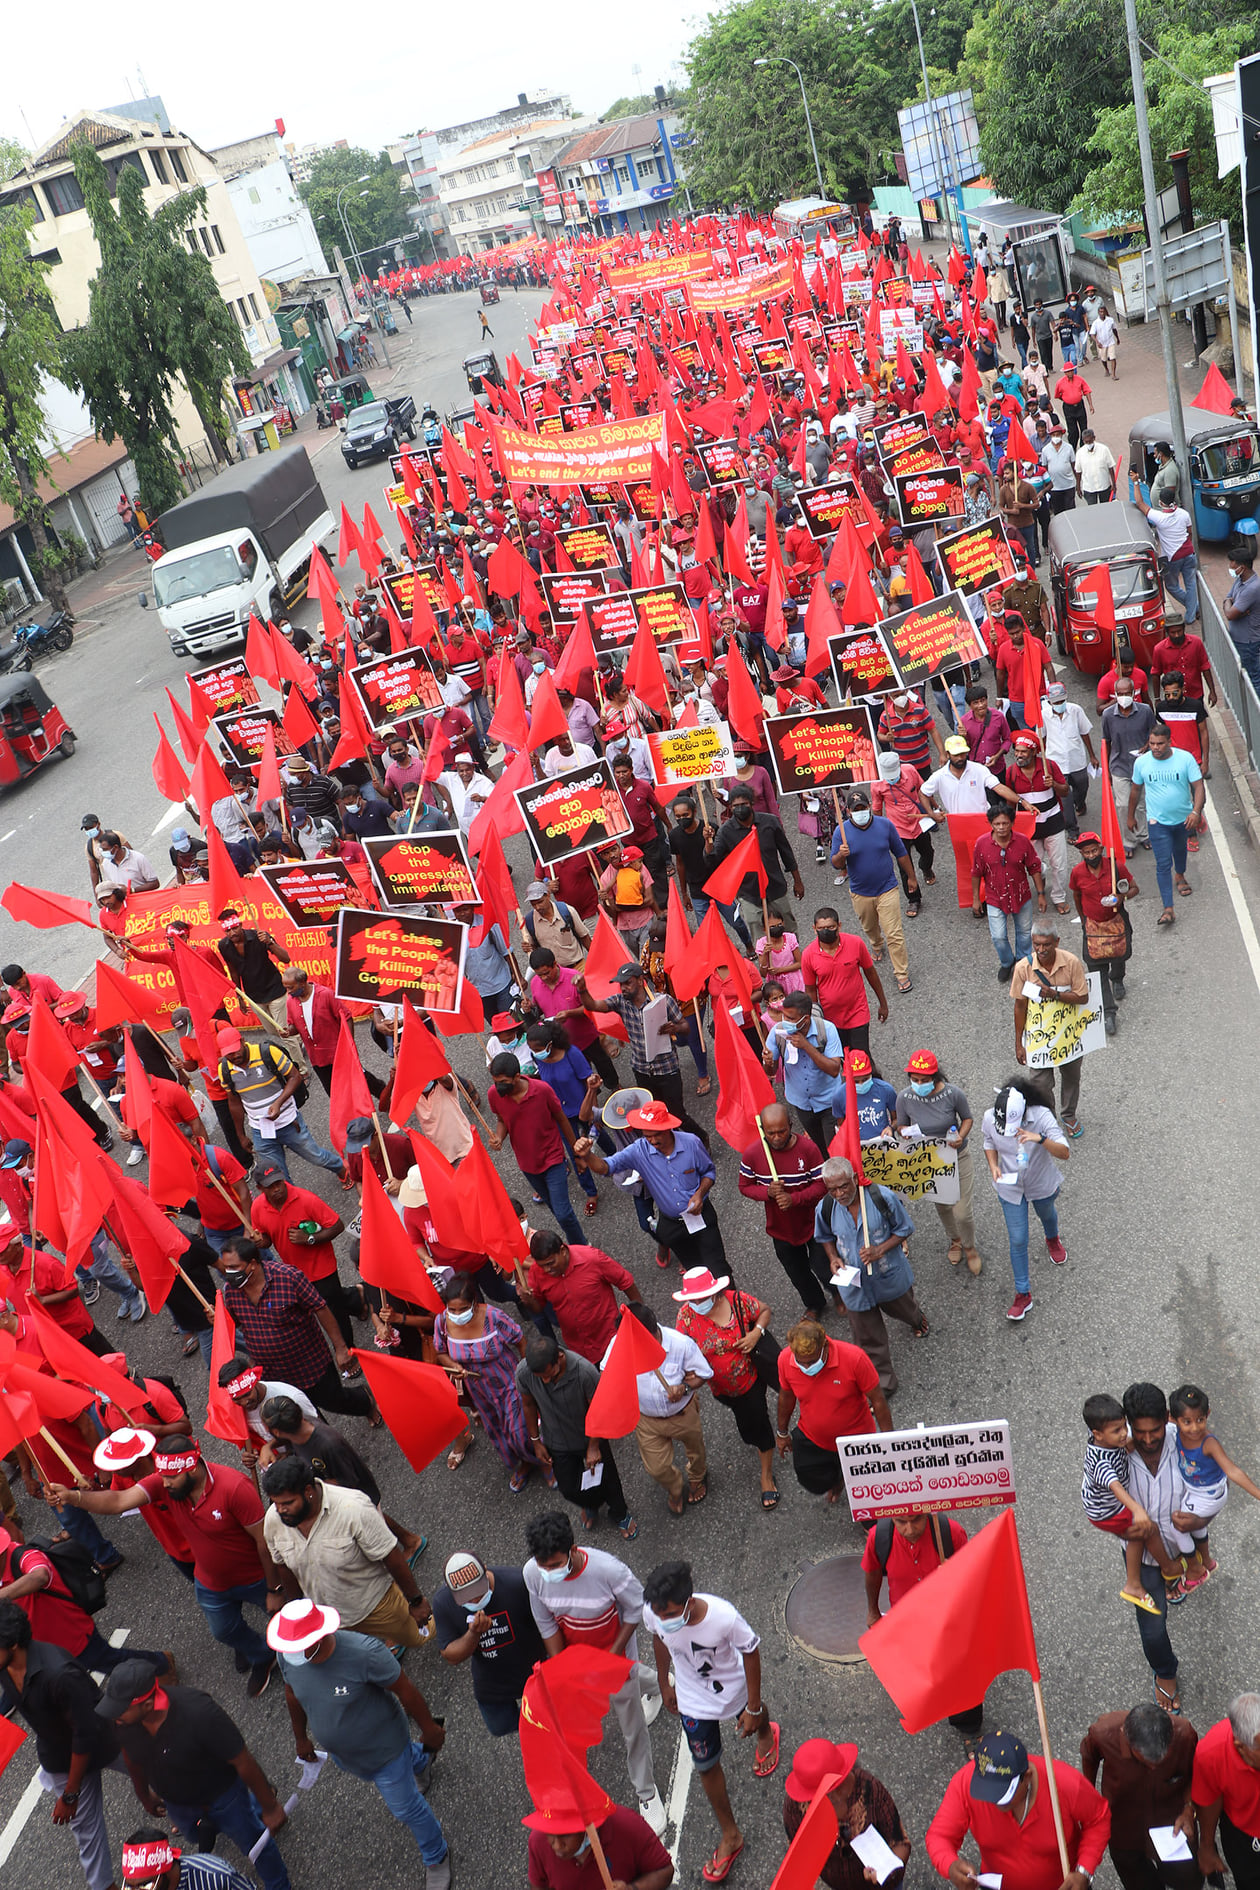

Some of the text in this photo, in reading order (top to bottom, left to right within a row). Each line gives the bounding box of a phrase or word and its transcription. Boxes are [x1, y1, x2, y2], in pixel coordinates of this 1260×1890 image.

[893, 447, 926, 469] Do not
[511, 465, 536, 478] Let's
[540, 467, 560, 479] end
[562, 468, 581, 479] the
[597, 465, 624, 479] year
[742, 595, 760, 606] EA7
[890, 605, 954, 638] Let's chase out
[893, 615, 961, 650] the Government
[908, 632, 955, 658] which sells
[900, 638, 975, 674] national treasures
[788, 722, 853, 739] Let's chase
[793, 735, 854, 751] the People
[808, 748, 845, 762] Killing
[794, 758, 864, 776] Government
[398, 845, 431, 856] Stop
[408, 858, 430, 868] the
[389, 869, 464, 883] oppression
[392, 881, 473, 895] immediately
[365, 927, 443, 947] Let's chase
[366, 943, 439, 961] the People
[379, 960, 424, 977] Killing
[358, 972, 442, 992] Government
[851, 1467, 1011, 1500] පාලනයක් ගොඩනගමු
